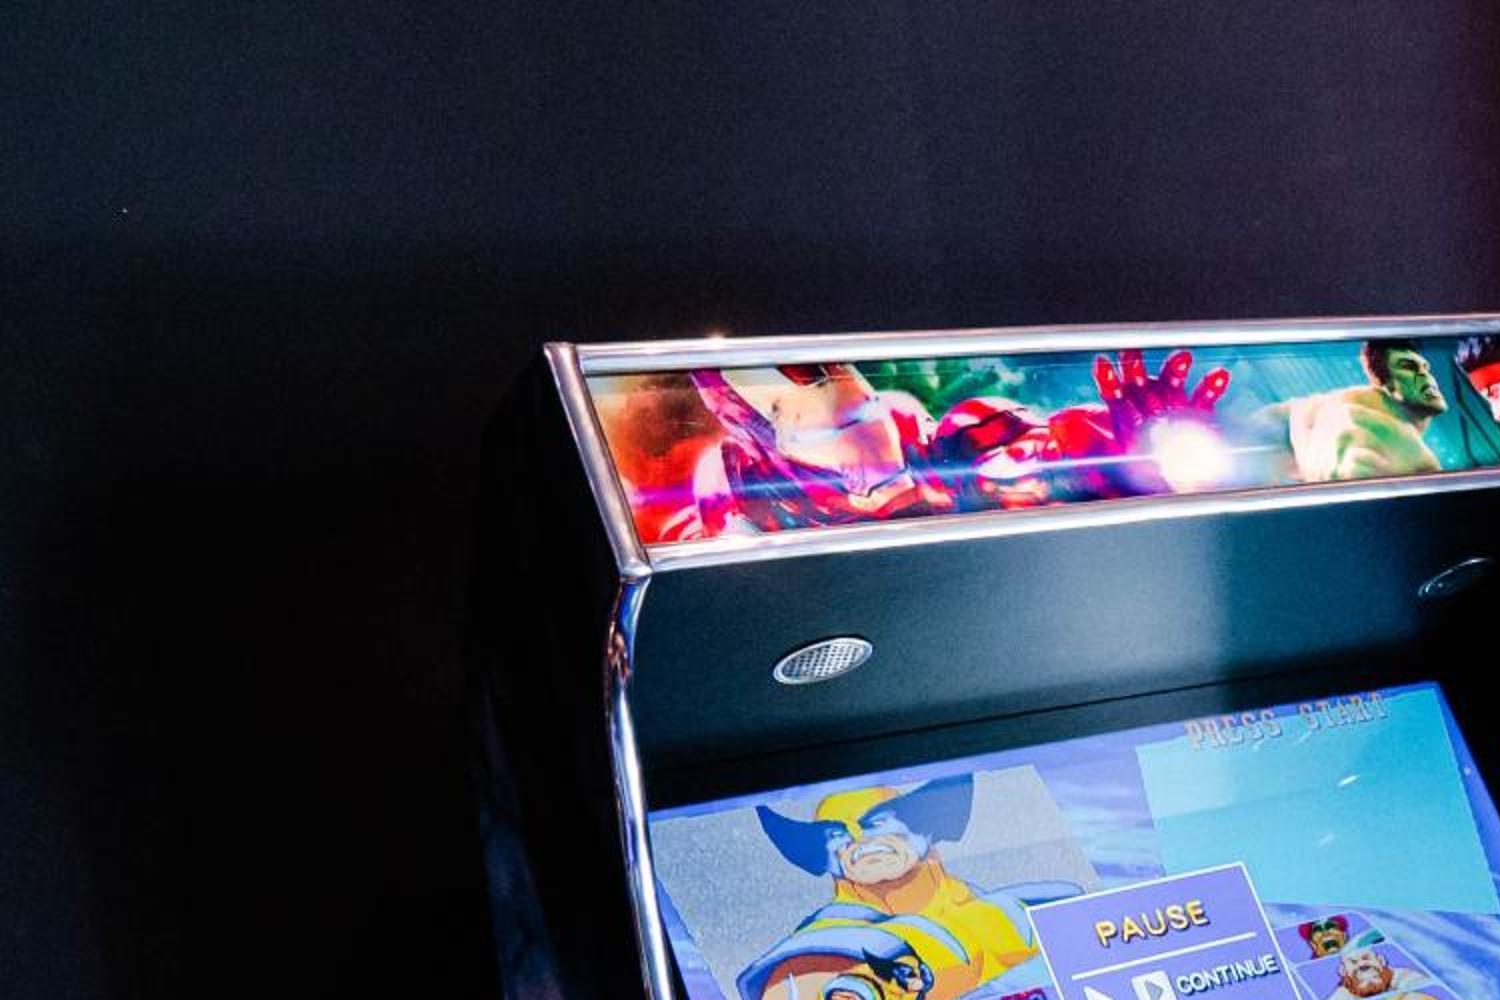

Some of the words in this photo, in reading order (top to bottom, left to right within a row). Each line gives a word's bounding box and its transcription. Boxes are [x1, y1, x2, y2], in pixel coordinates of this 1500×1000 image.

[1184, 708, 1283, 750] PRESS
[1299, 691, 1389, 731] START
[1095, 900, 1209, 947] PAUSE
[1176, 953, 1281, 997] CONTINUE
